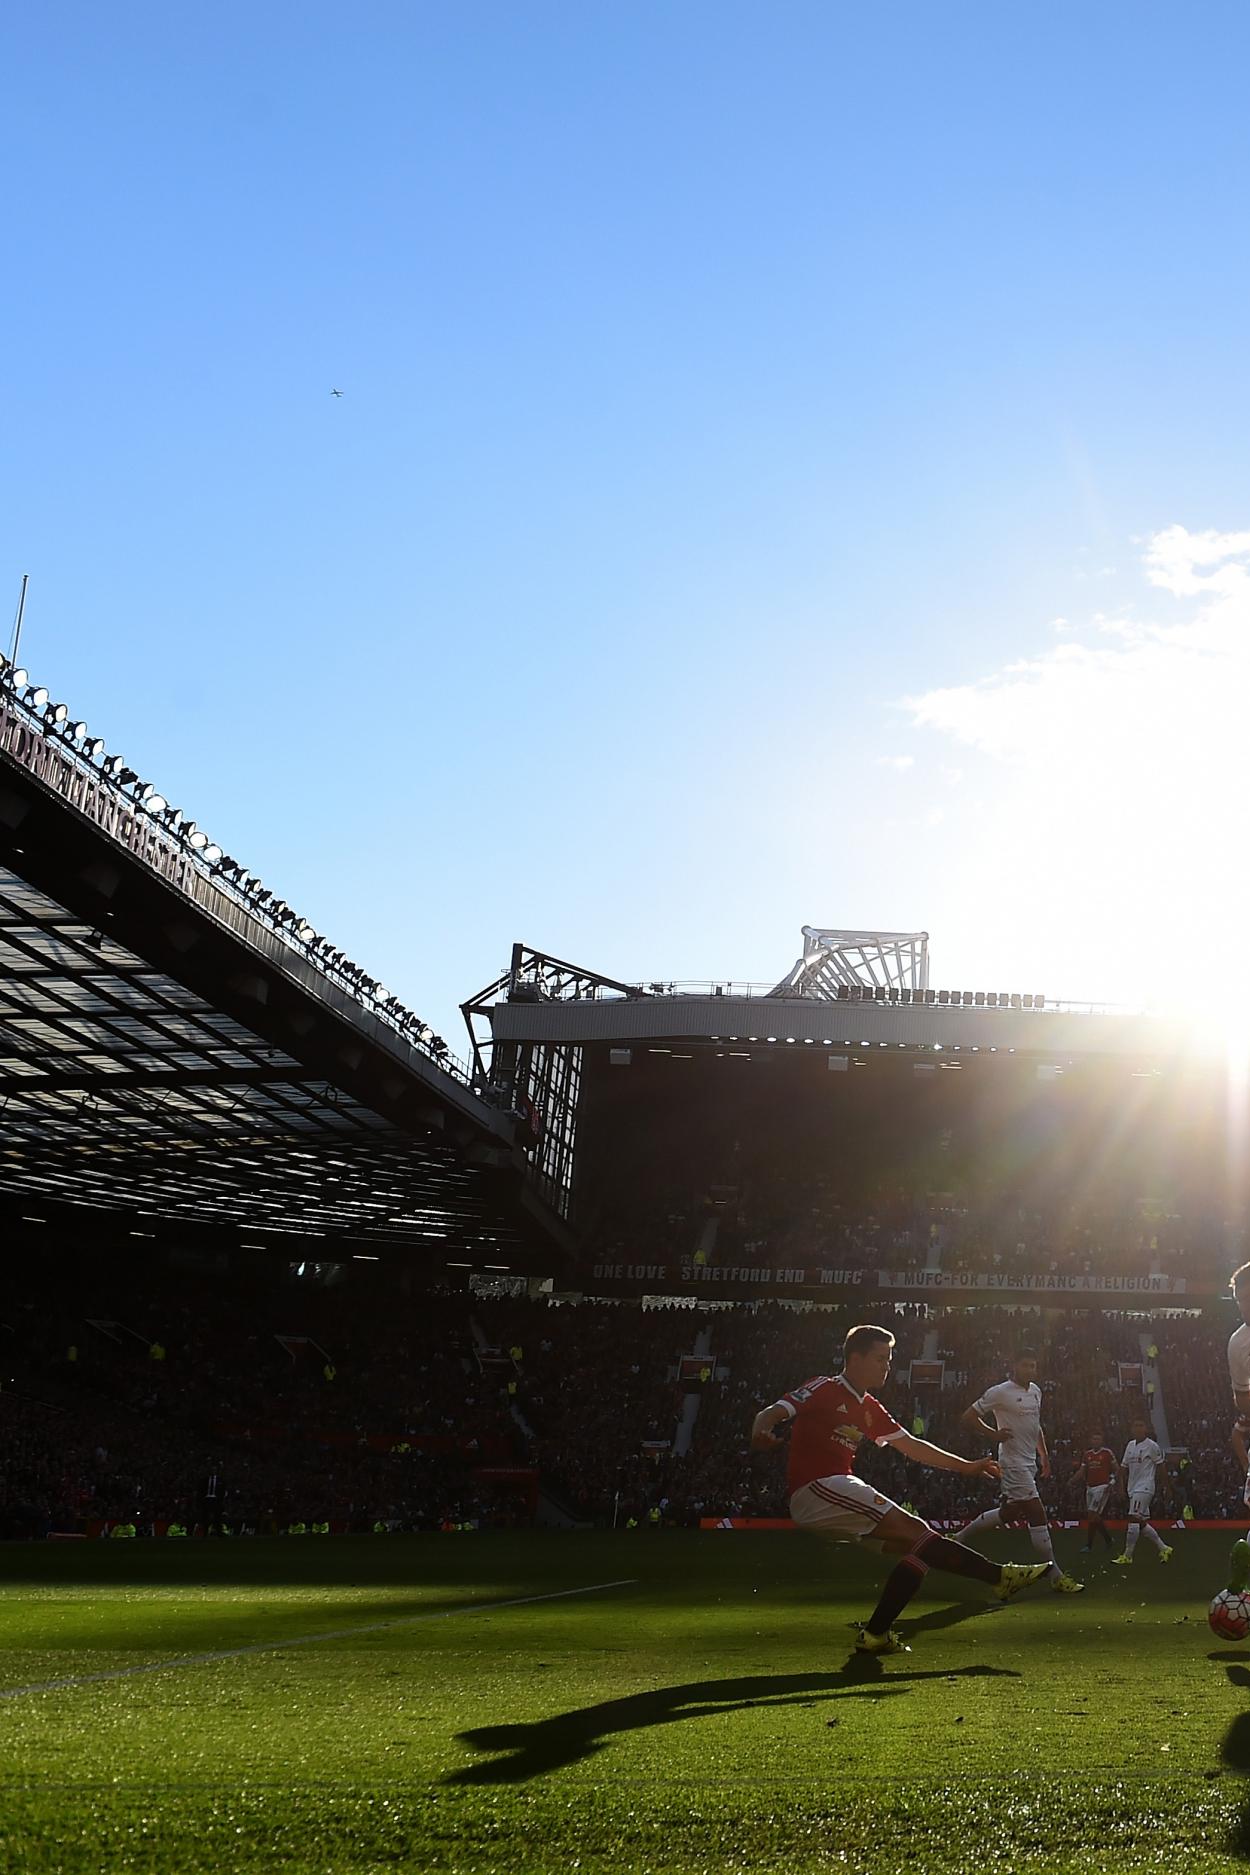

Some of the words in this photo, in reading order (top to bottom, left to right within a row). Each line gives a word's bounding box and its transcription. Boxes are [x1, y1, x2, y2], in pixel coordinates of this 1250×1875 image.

[592, 1264, 623, 1280] ONE
[626, 1264, 666, 1280] LOVE
[681, 1265, 769, 1282] STRETFORD
[776, 1269, 805, 1283] END
[1095, 1278, 1159, 1290] RELIGION
